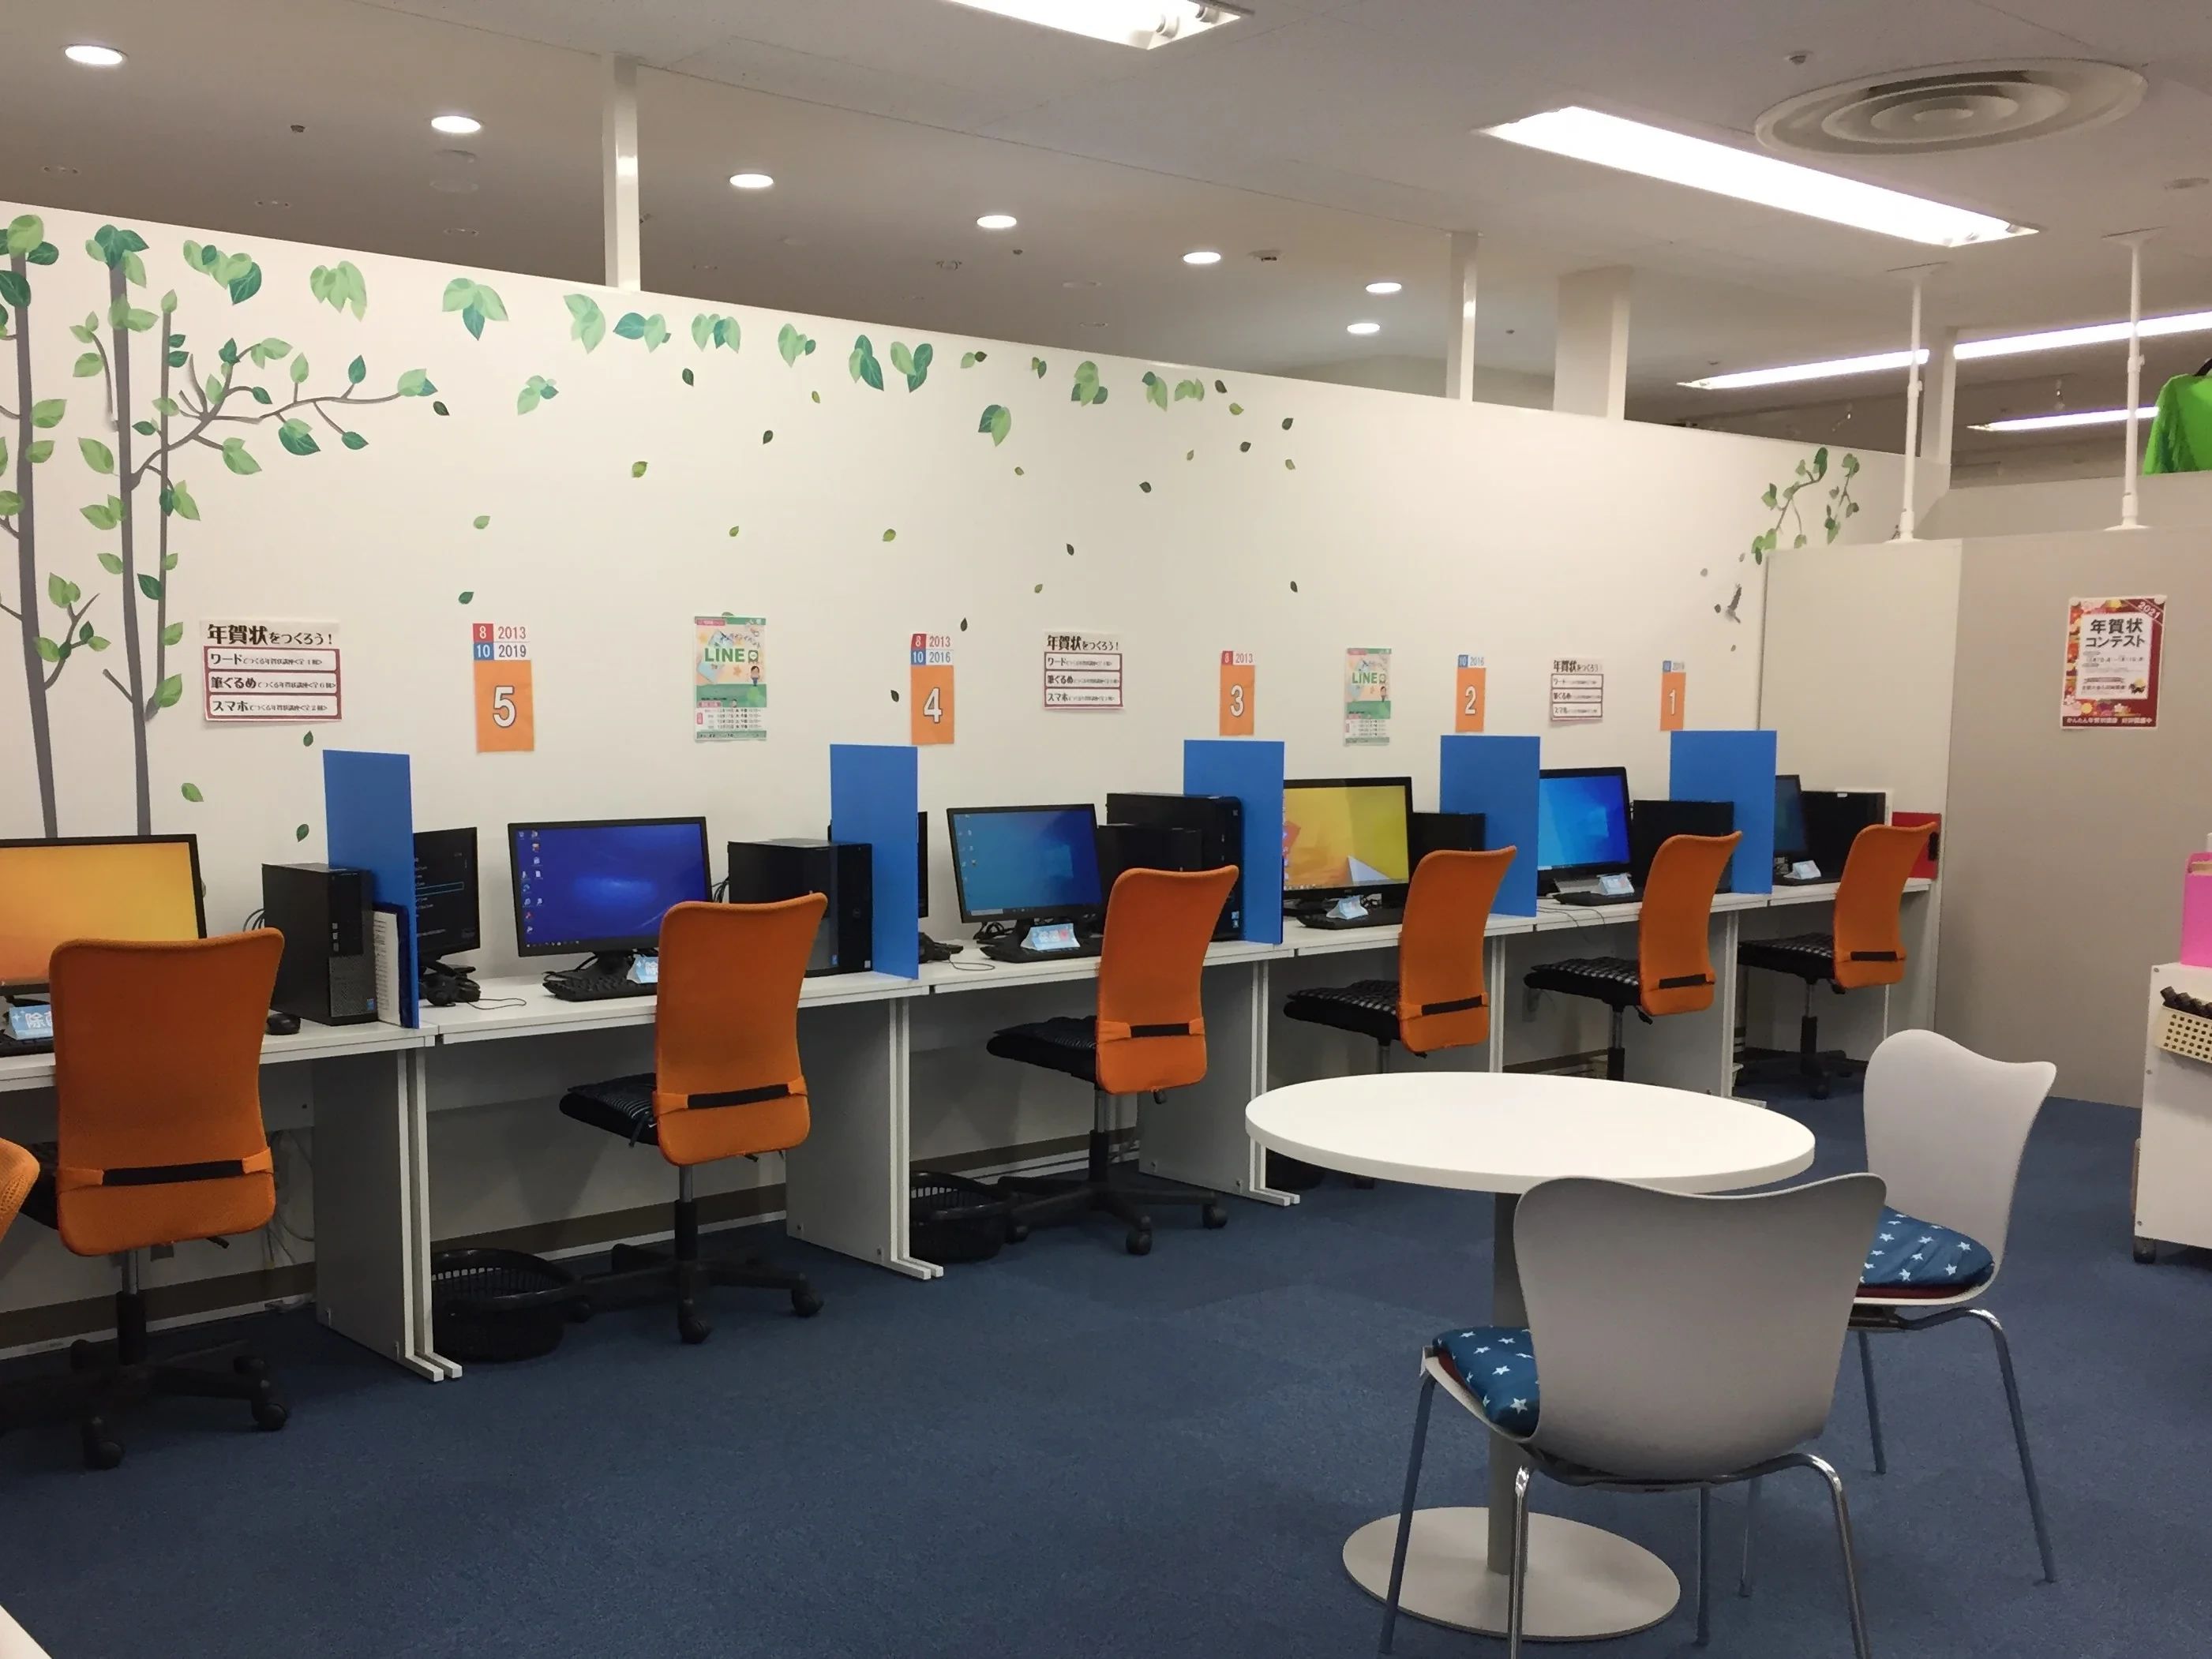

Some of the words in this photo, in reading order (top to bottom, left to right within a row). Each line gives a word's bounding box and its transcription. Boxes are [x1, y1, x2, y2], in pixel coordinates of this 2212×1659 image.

[2138, 601, 2161, 620] 2021
[479, 625, 487, 639] 8
[498, 626, 527, 639] 2013
[2090, 618, 2143, 635] 年賀状
[915, 635, 921, 647] 8
[929, 635, 950, 647] 2013
[2085, 635, 2145, 648] コンテスト
[477, 644, 491, 658] 10
[498, 644, 527, 658] 2019
[704, 647, 744, 663] LINE
[913, 651, 924, 663] 10
[929, 651, 950, 663] 2016
[1235, 653, 1253, 664] 2013
[1352, 672, 1378, 684] LINE
[492, 685, 516, 728] 5
[923, 687, 943, 724] 4
[1230, 684, 1244, 717] 3
[1465, 685, 1476, 716] 2
[1669, 688, 1676, 716] 1
